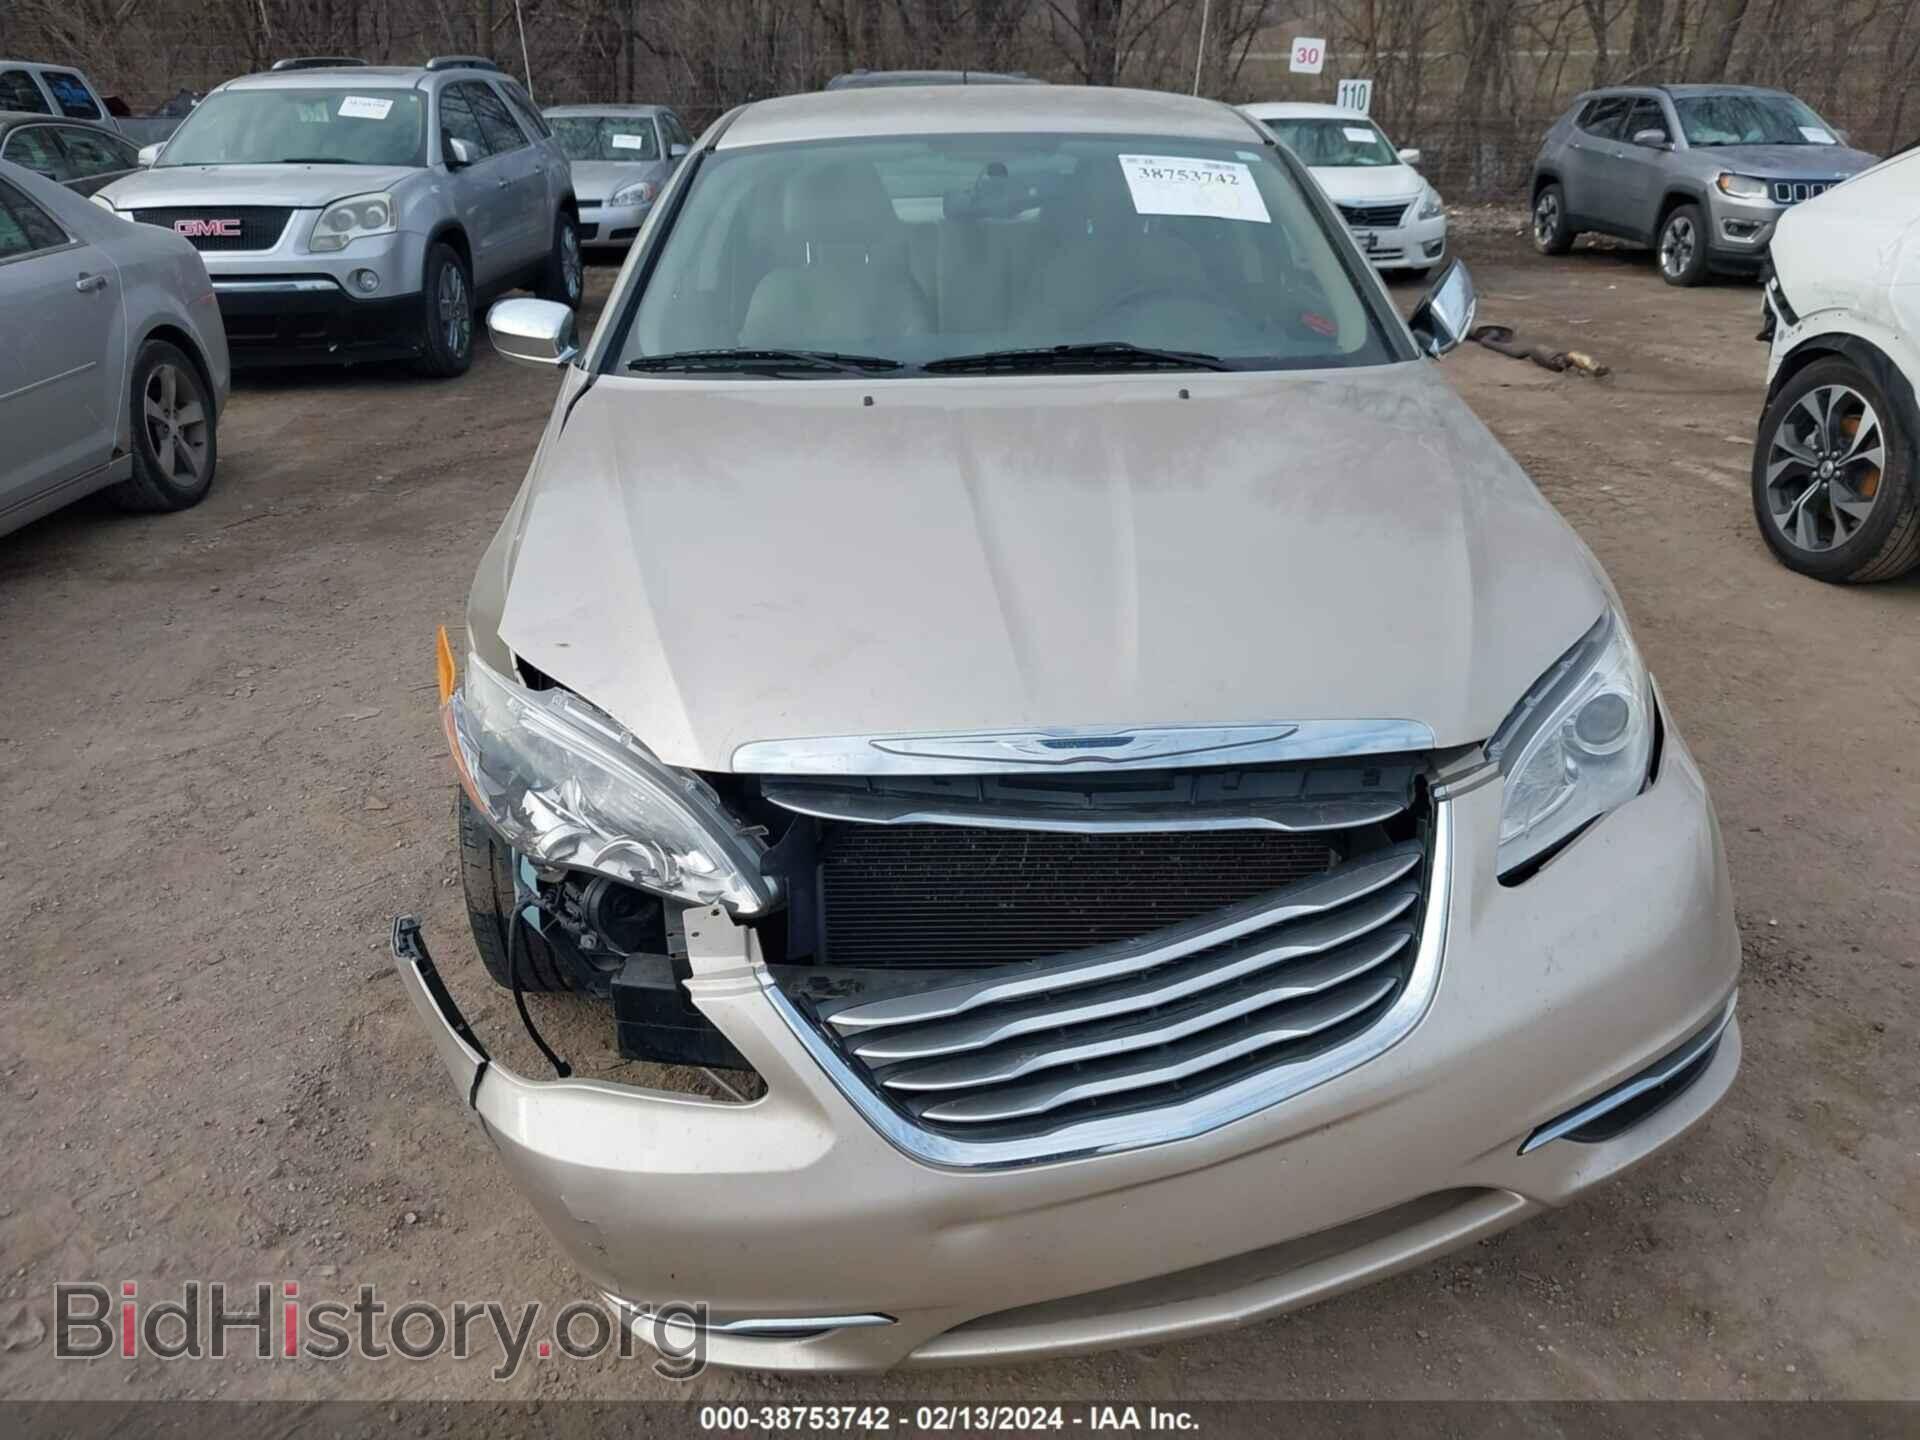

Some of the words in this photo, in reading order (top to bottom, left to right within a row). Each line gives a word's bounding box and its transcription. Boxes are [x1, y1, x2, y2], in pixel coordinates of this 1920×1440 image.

[1297, 47, 1319, 64] 30
[1342, 83, 1367, 111] 110
[1138, 167, 1240, 185] 38753742
[174, 219, 241, 236] GMC
